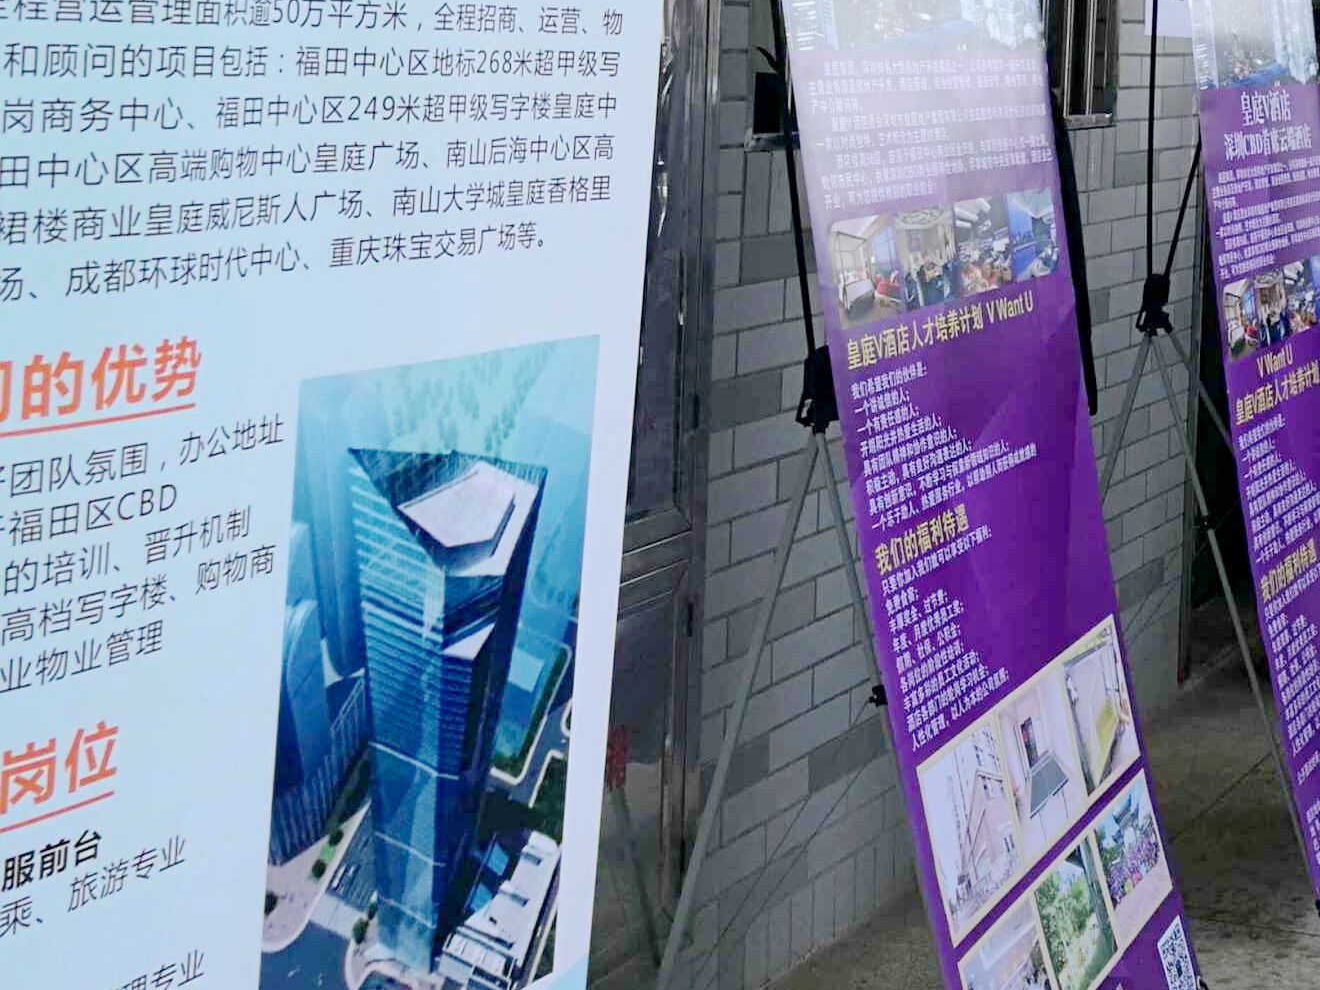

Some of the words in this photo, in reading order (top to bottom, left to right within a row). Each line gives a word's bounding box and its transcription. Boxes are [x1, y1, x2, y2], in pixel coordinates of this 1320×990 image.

[1240, 89, 1292, 126] 皇庭V酒店
[0, 412, 284, 498] 团队氛围，办公地址
[0, 483, 178, 547] 福田区CBD
[875, 503, 969, 575] 我们的福利待遇
[0, 619, 164, 694] 业物业管理
[0, 719, 119, 816] 岗位
[1, 829, 102, 893] 服前台
